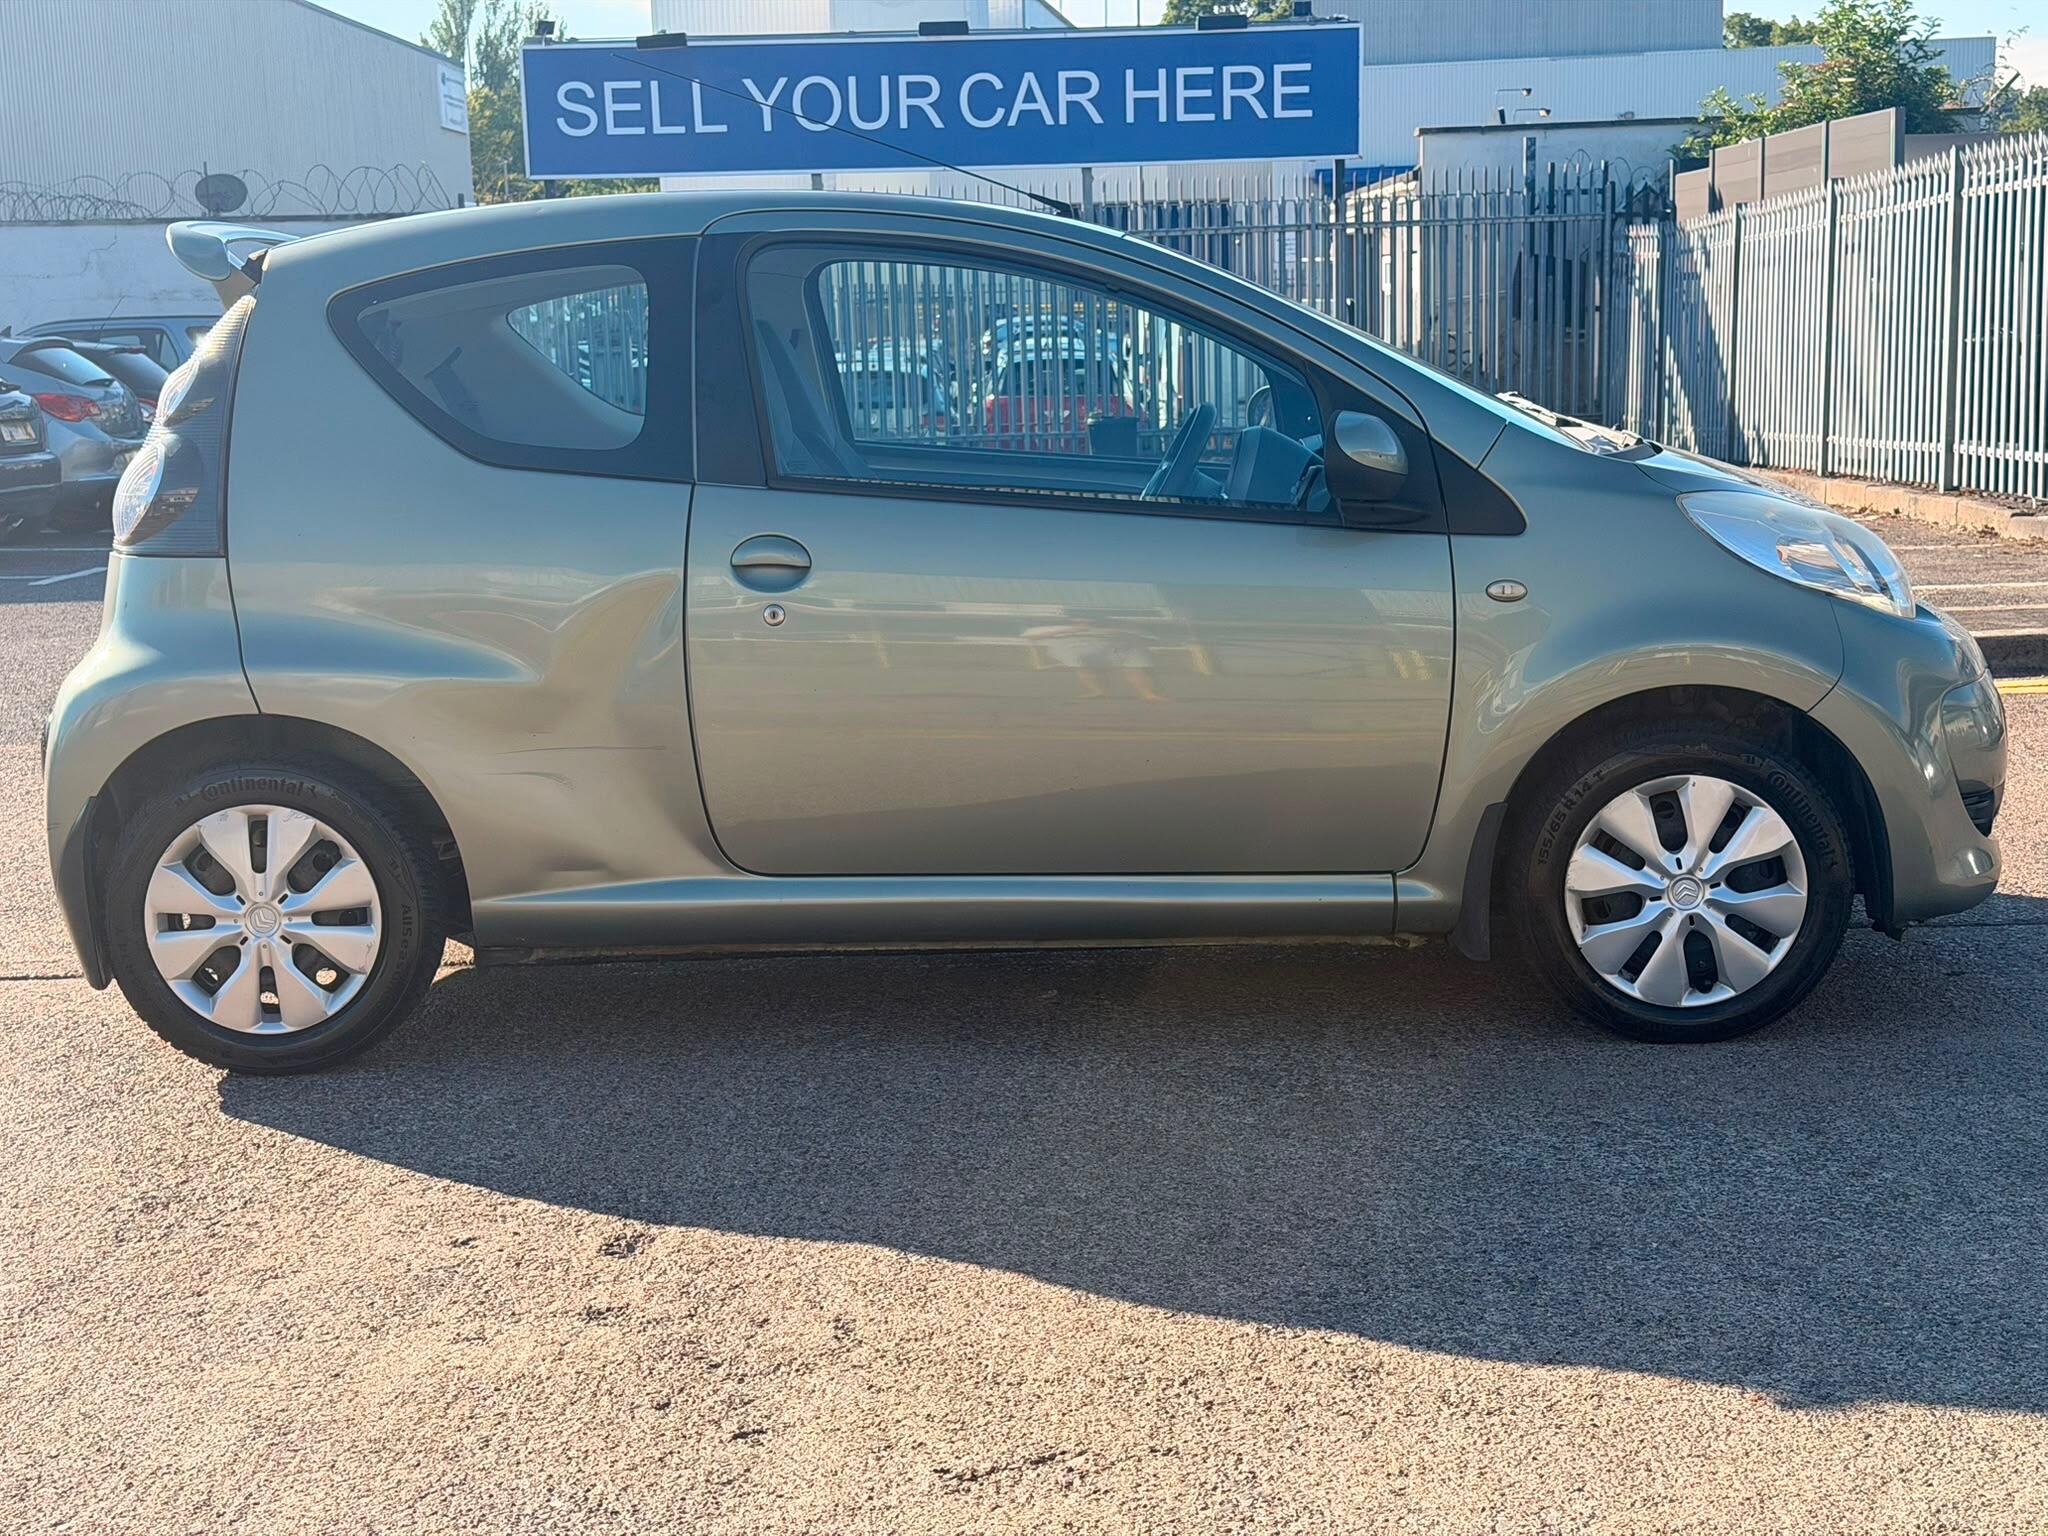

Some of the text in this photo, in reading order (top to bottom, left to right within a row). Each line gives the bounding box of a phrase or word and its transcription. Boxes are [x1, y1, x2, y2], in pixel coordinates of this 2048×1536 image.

[556, 63, 1313, 137] SELL YOUR CAR HERE
[202, 775, 304, 801] Continental
[1768, 769, 1836, 859] Continental
